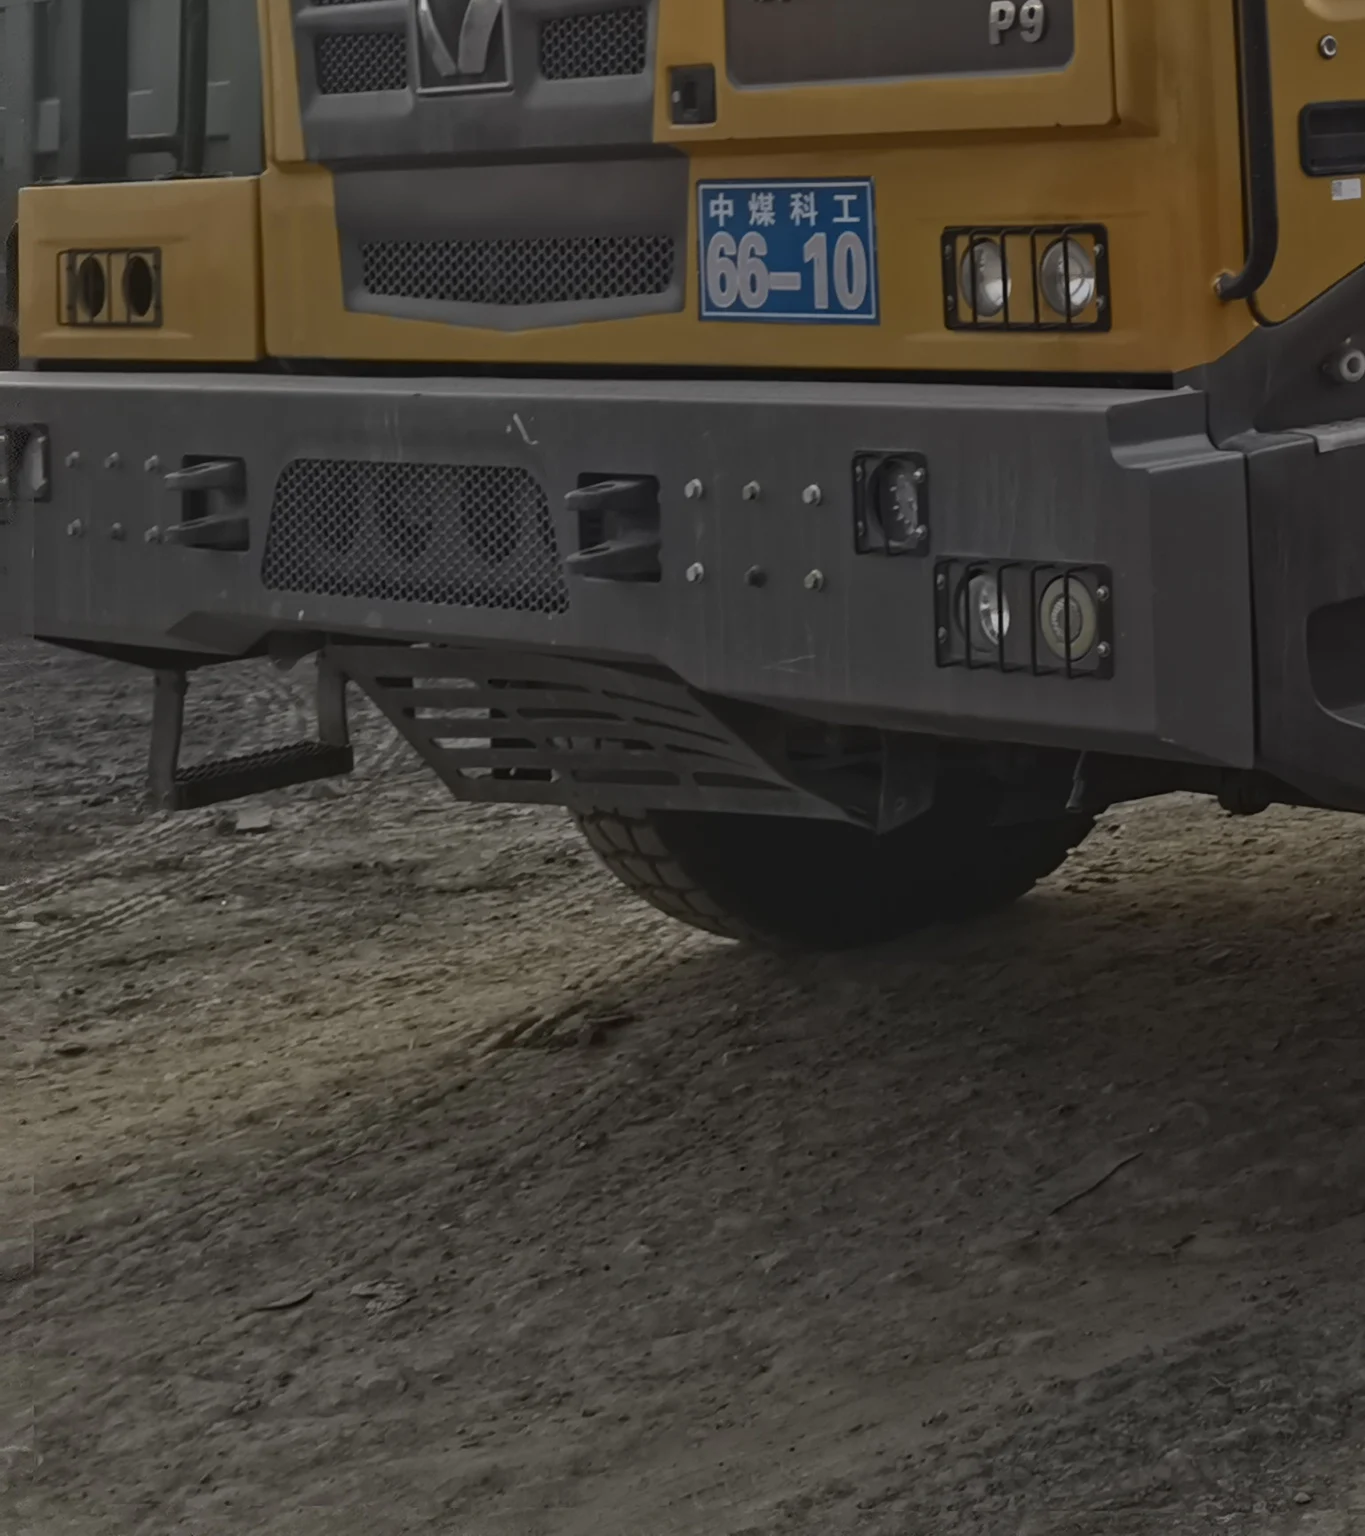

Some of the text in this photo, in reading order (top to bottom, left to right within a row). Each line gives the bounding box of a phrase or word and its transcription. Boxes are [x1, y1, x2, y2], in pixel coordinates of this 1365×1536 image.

[709, 191, 860, 227] 中煤科工
[706, 231, 867, 310] 66-10
